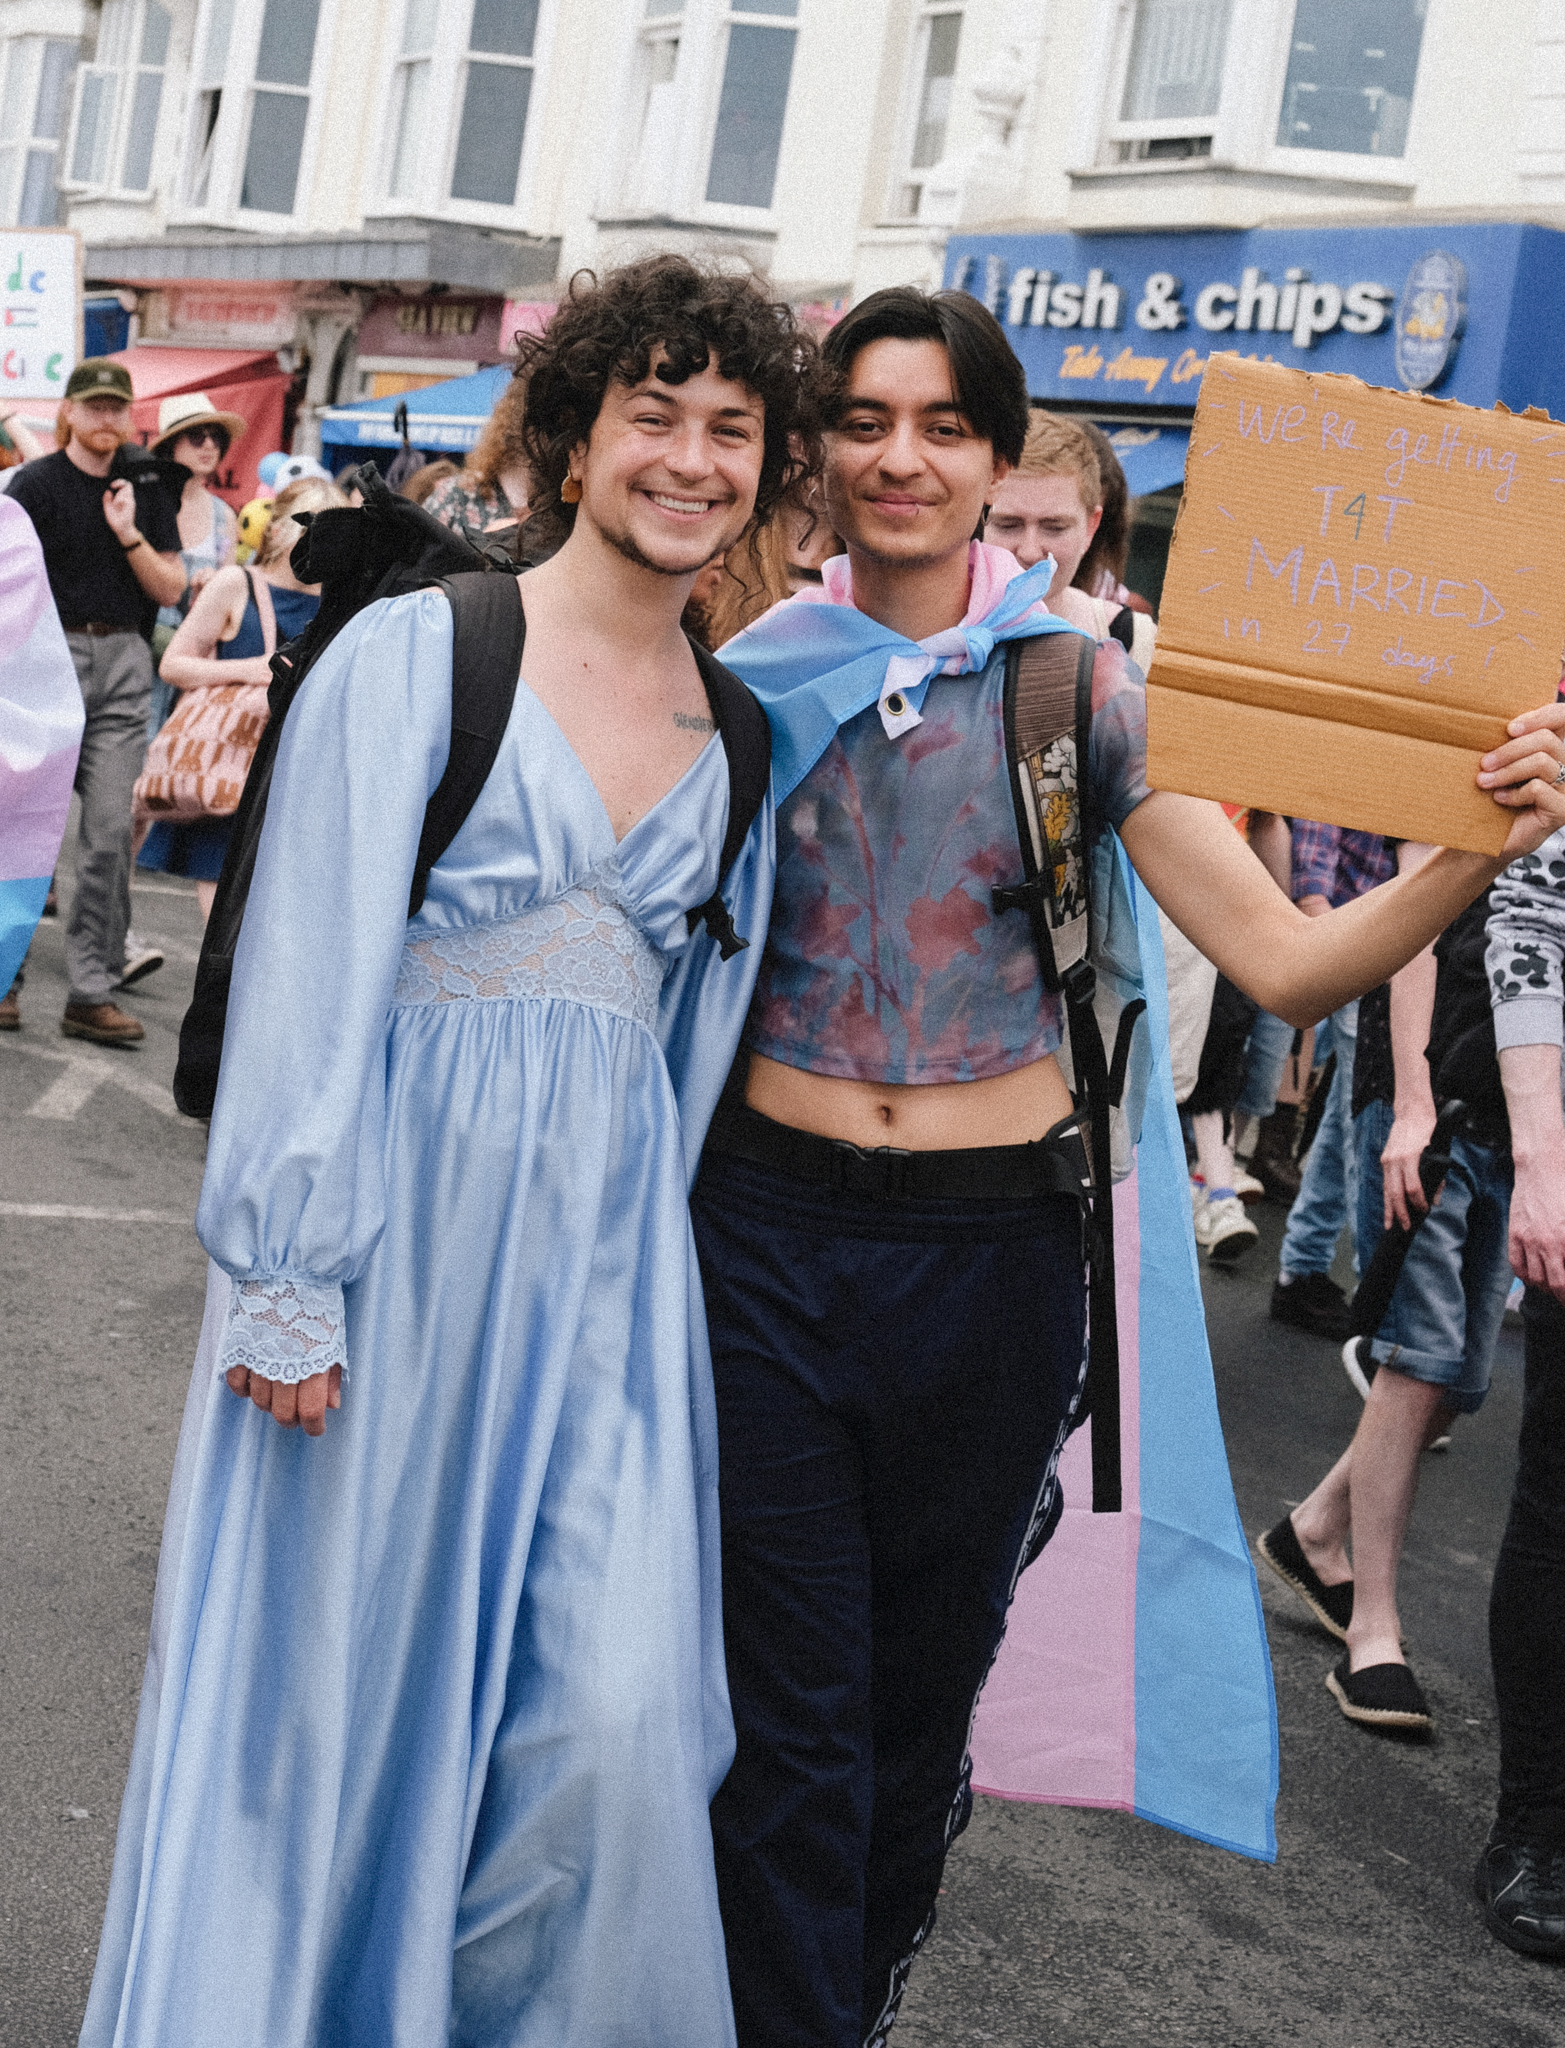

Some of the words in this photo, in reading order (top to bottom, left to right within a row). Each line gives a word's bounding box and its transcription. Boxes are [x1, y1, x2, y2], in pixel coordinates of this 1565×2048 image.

[1008, 267, 1121, 328] fish
[1135, 272, 1187, 331] &
[1194, 267, 1394, 349] chips
[1104, 346, 1169, 394] Away
[1384, 423, 1521, 504] getting
[1312, 484, 1414, 544] T4T
[1244, 535, 1506, 629] MARRIED
[1221, 612, 1261, 643] in
[1302, 620, 1353, 656] 27
